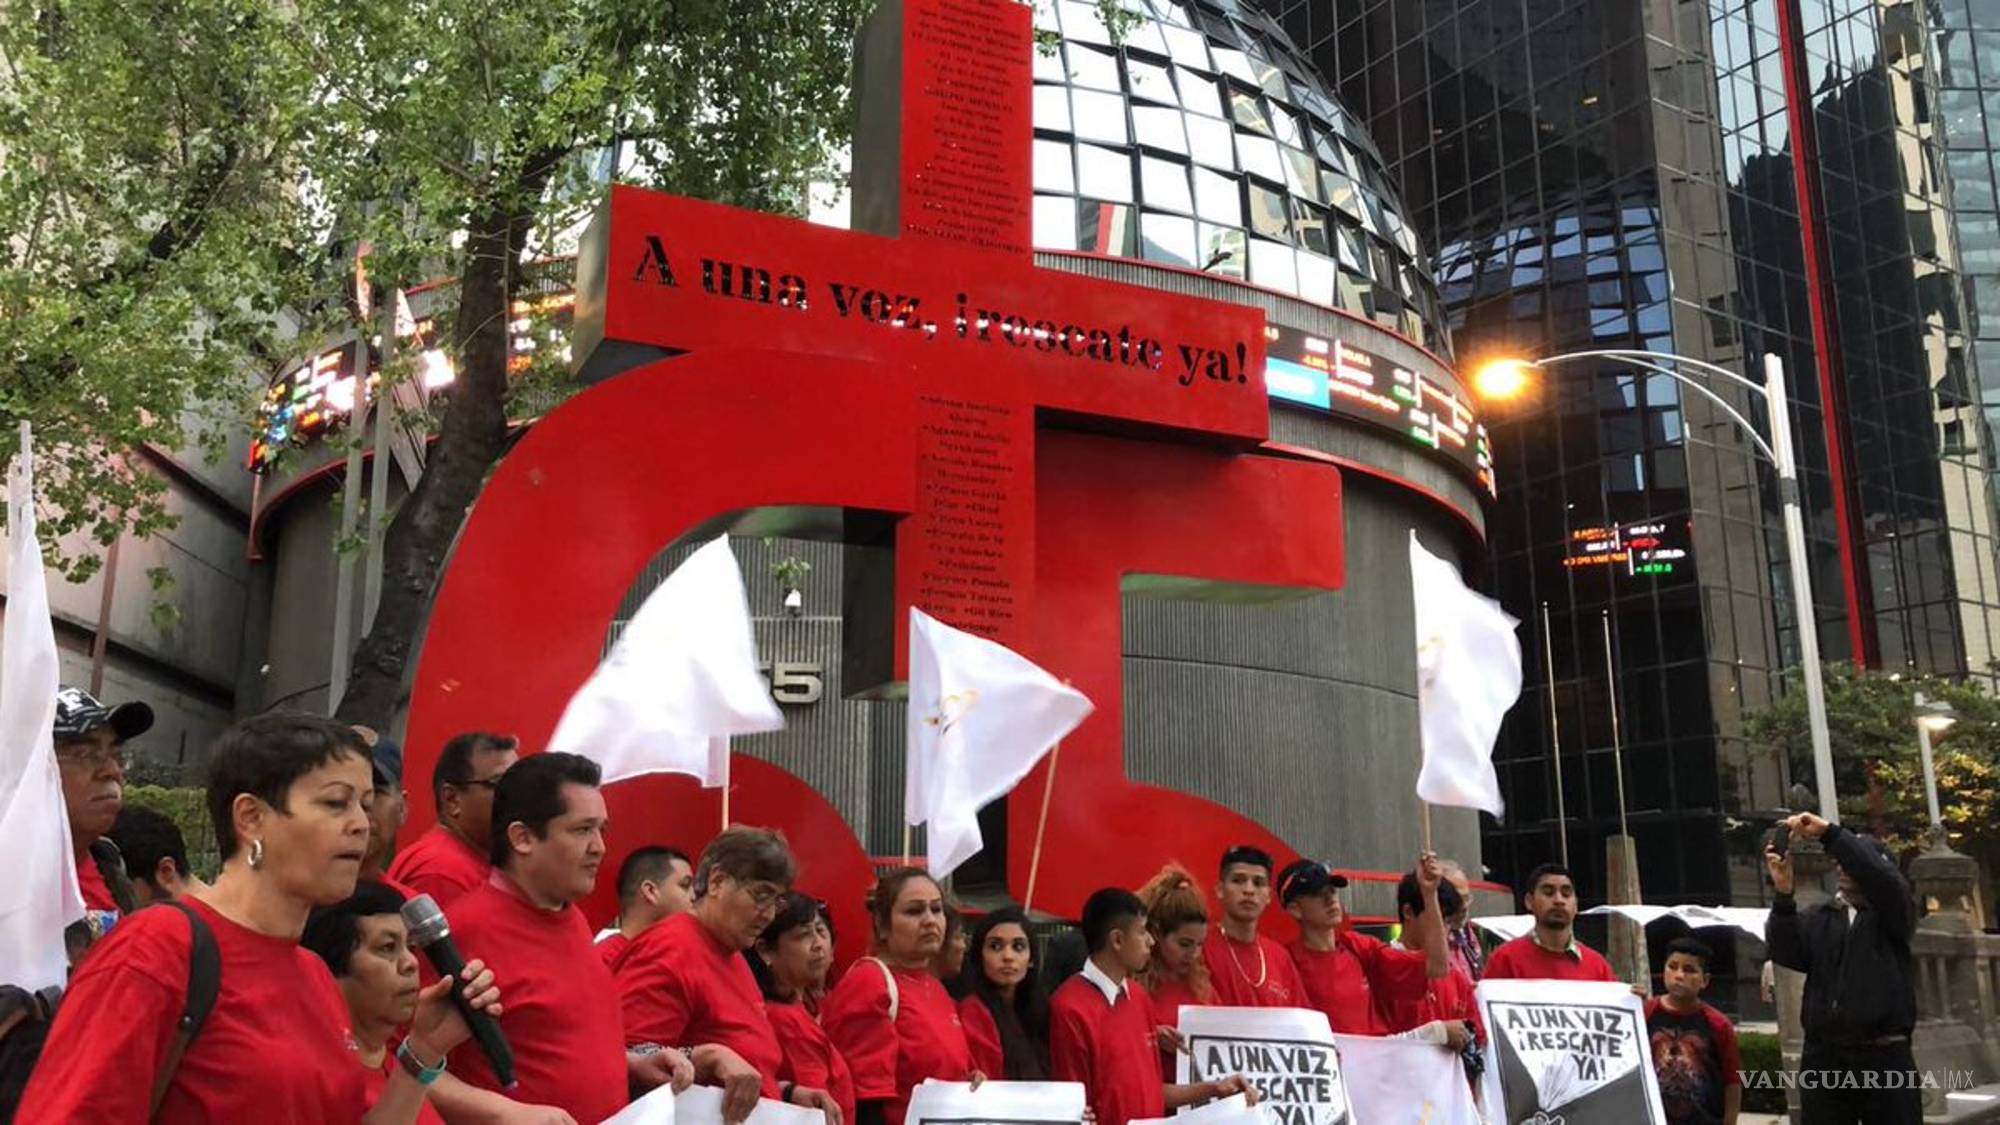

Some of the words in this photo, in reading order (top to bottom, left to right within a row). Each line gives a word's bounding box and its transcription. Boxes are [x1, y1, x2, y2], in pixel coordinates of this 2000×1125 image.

[632, 234, 681, 289] A
[699, 257, 808, 312] una
[828, 282, 937, 340] voz,
[1178, 342, 1248, 387] ya!
[1508, 1008, 1526, 1029] A
[1527, 1008, 1576, 1029] UNA
[1517, 1030, 1622, 1058] ¡RESCATE
[1207, 1045, 1227, 1075] A
[1229, 1045, 1280, 1074] UNA
[1571, 1053, 1607, 1081] YA!
